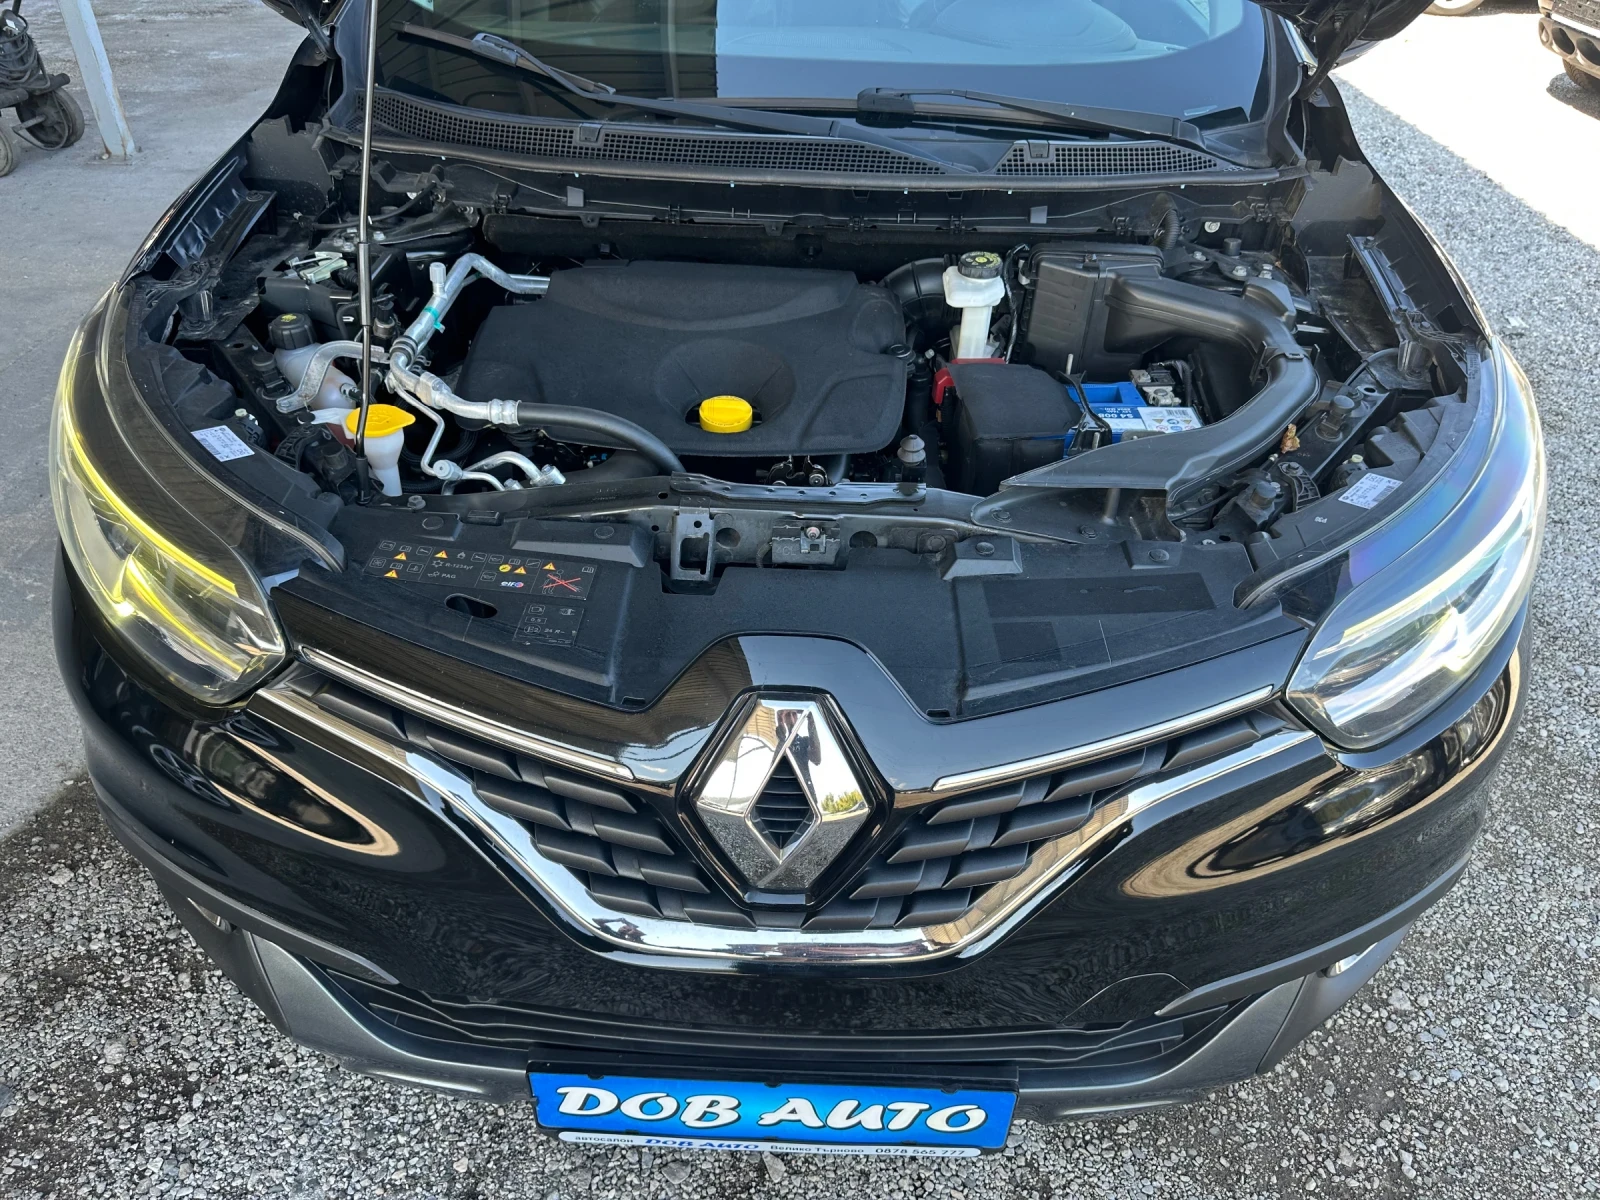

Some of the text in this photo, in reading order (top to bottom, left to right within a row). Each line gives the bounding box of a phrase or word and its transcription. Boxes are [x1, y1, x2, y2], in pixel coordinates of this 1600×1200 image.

[556, 1086, 988, 1133] DOB AUTO
[645, 1138, 694, 1147] DOB
[699, 1141, 759, 1150] AUTO
